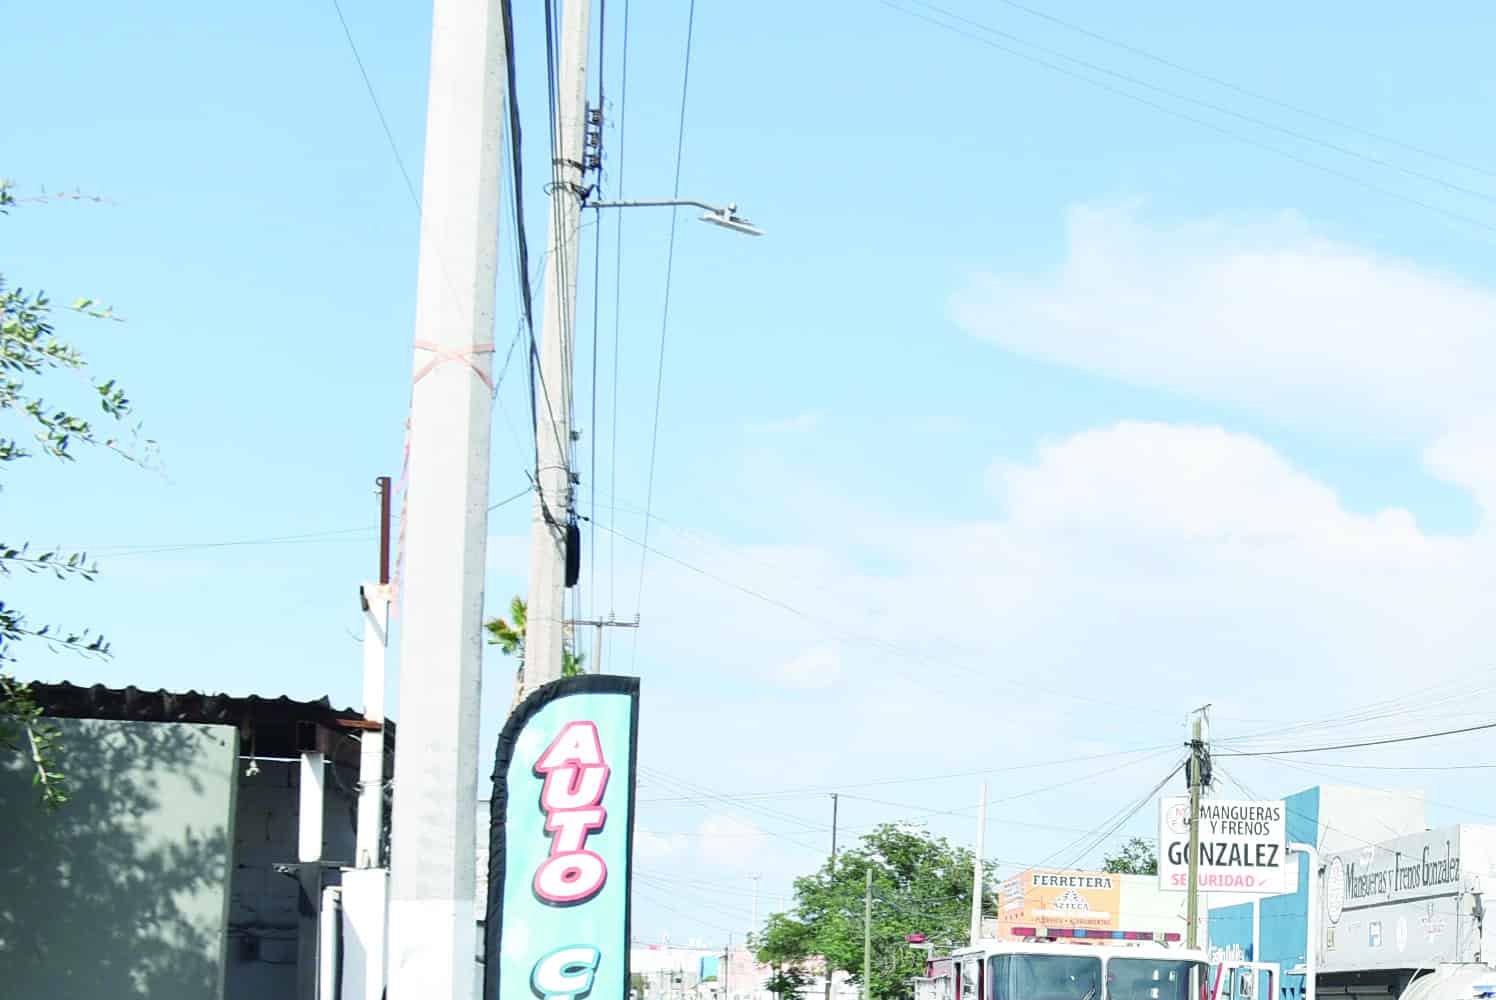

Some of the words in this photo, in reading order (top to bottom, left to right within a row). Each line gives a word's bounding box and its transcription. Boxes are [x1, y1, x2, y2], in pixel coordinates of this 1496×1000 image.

[534, 720, 611, 906] AUTO
[1200, 804, 1280, 821] MANGUERAS
[1210, 820, 1217, 835] Y
[1221, 820, 1270, 836] FRENOS
[1033, 874, 1112, 888] FERRETERA
[1171, 872, 1255, 887] SEURIDAD
[1345, 862, 1387, 900] Mangueras
[1394, 852, 1421, 892] Frenos
